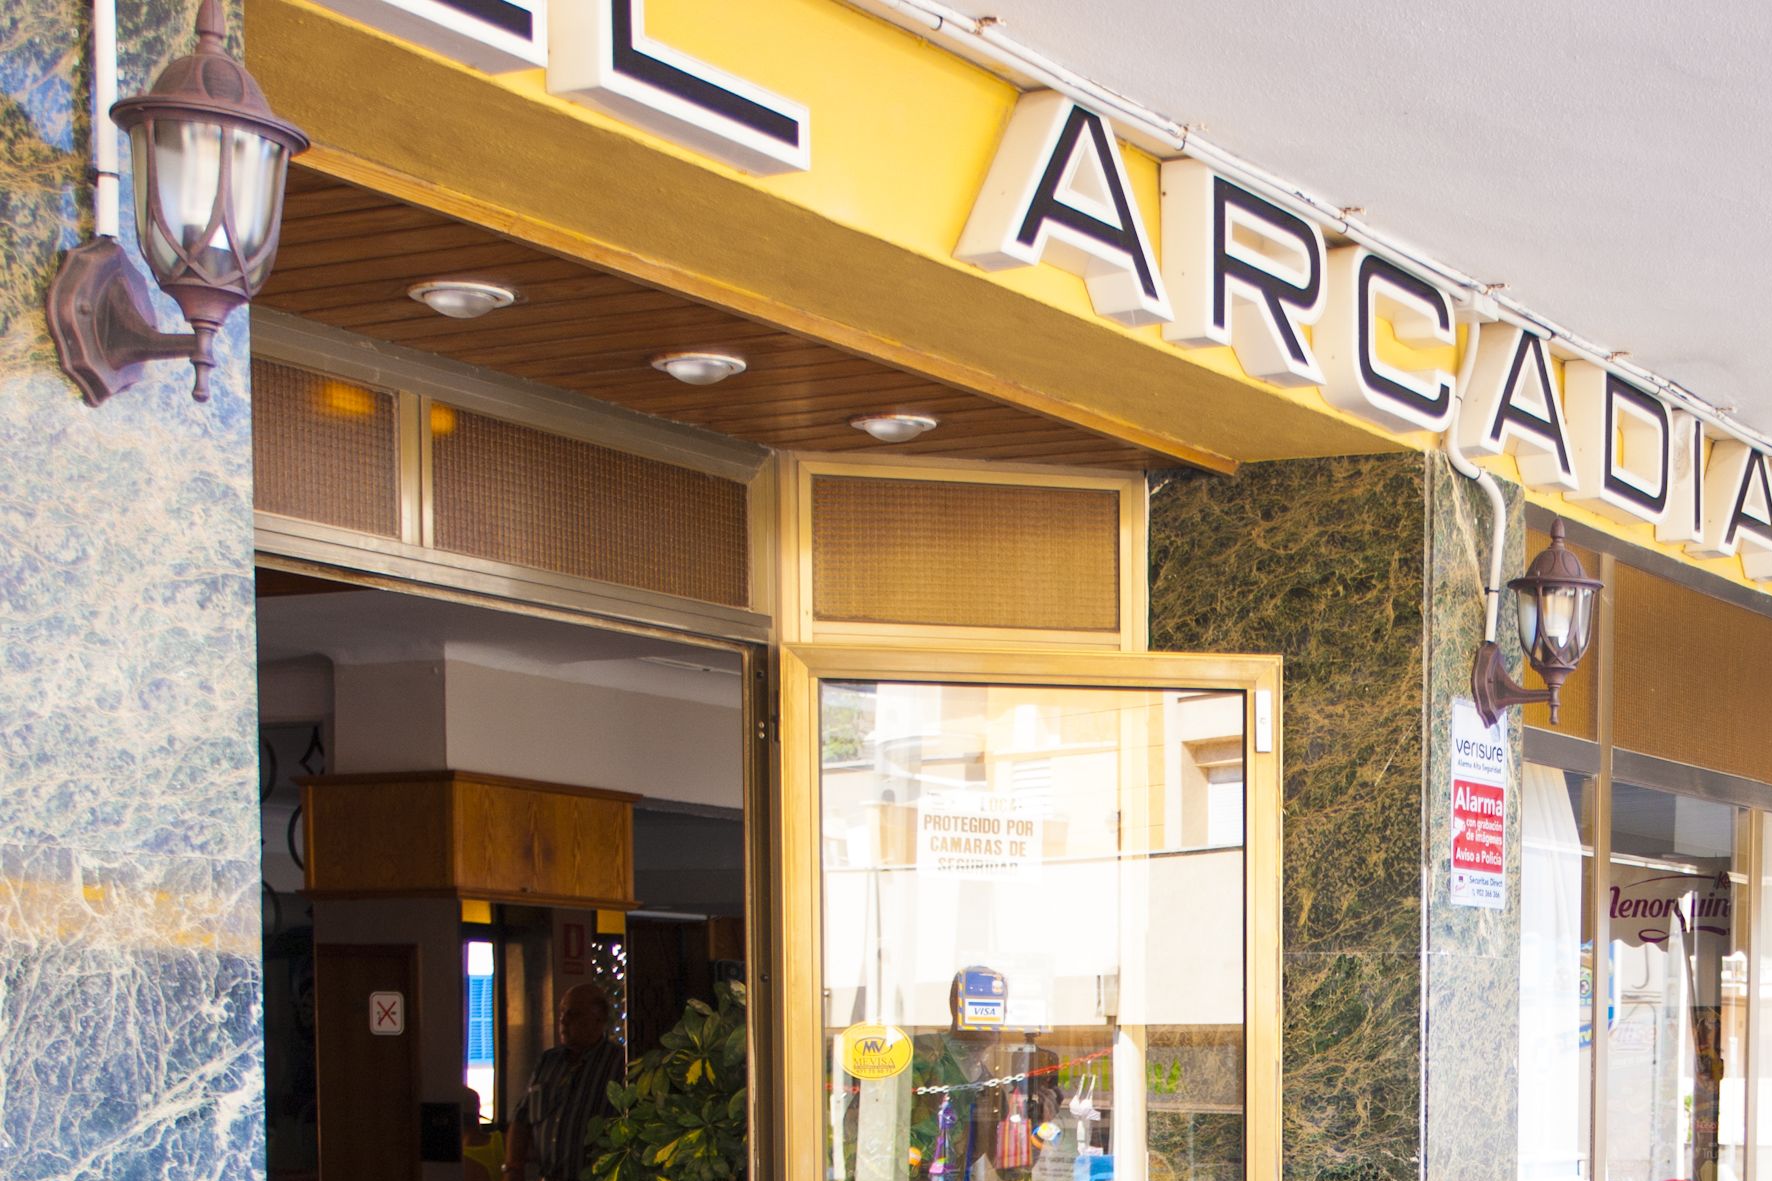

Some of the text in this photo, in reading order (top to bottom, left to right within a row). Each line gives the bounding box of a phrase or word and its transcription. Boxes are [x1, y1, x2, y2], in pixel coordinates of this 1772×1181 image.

[1455, 738, 1503, 763] verisure
[1455, 786, 1503, 817] Alarma
[923, 814, 1034, 836] PROTEGIDO POR
[1465, 828, 1475, 841] de
[930, 835, 1027, 857] CAMARAS DE
[1455, 847, 1475, 862] Aviso
[1475, 853, 1481, 863] a
[974, 1007, 996, 1016] VISA
